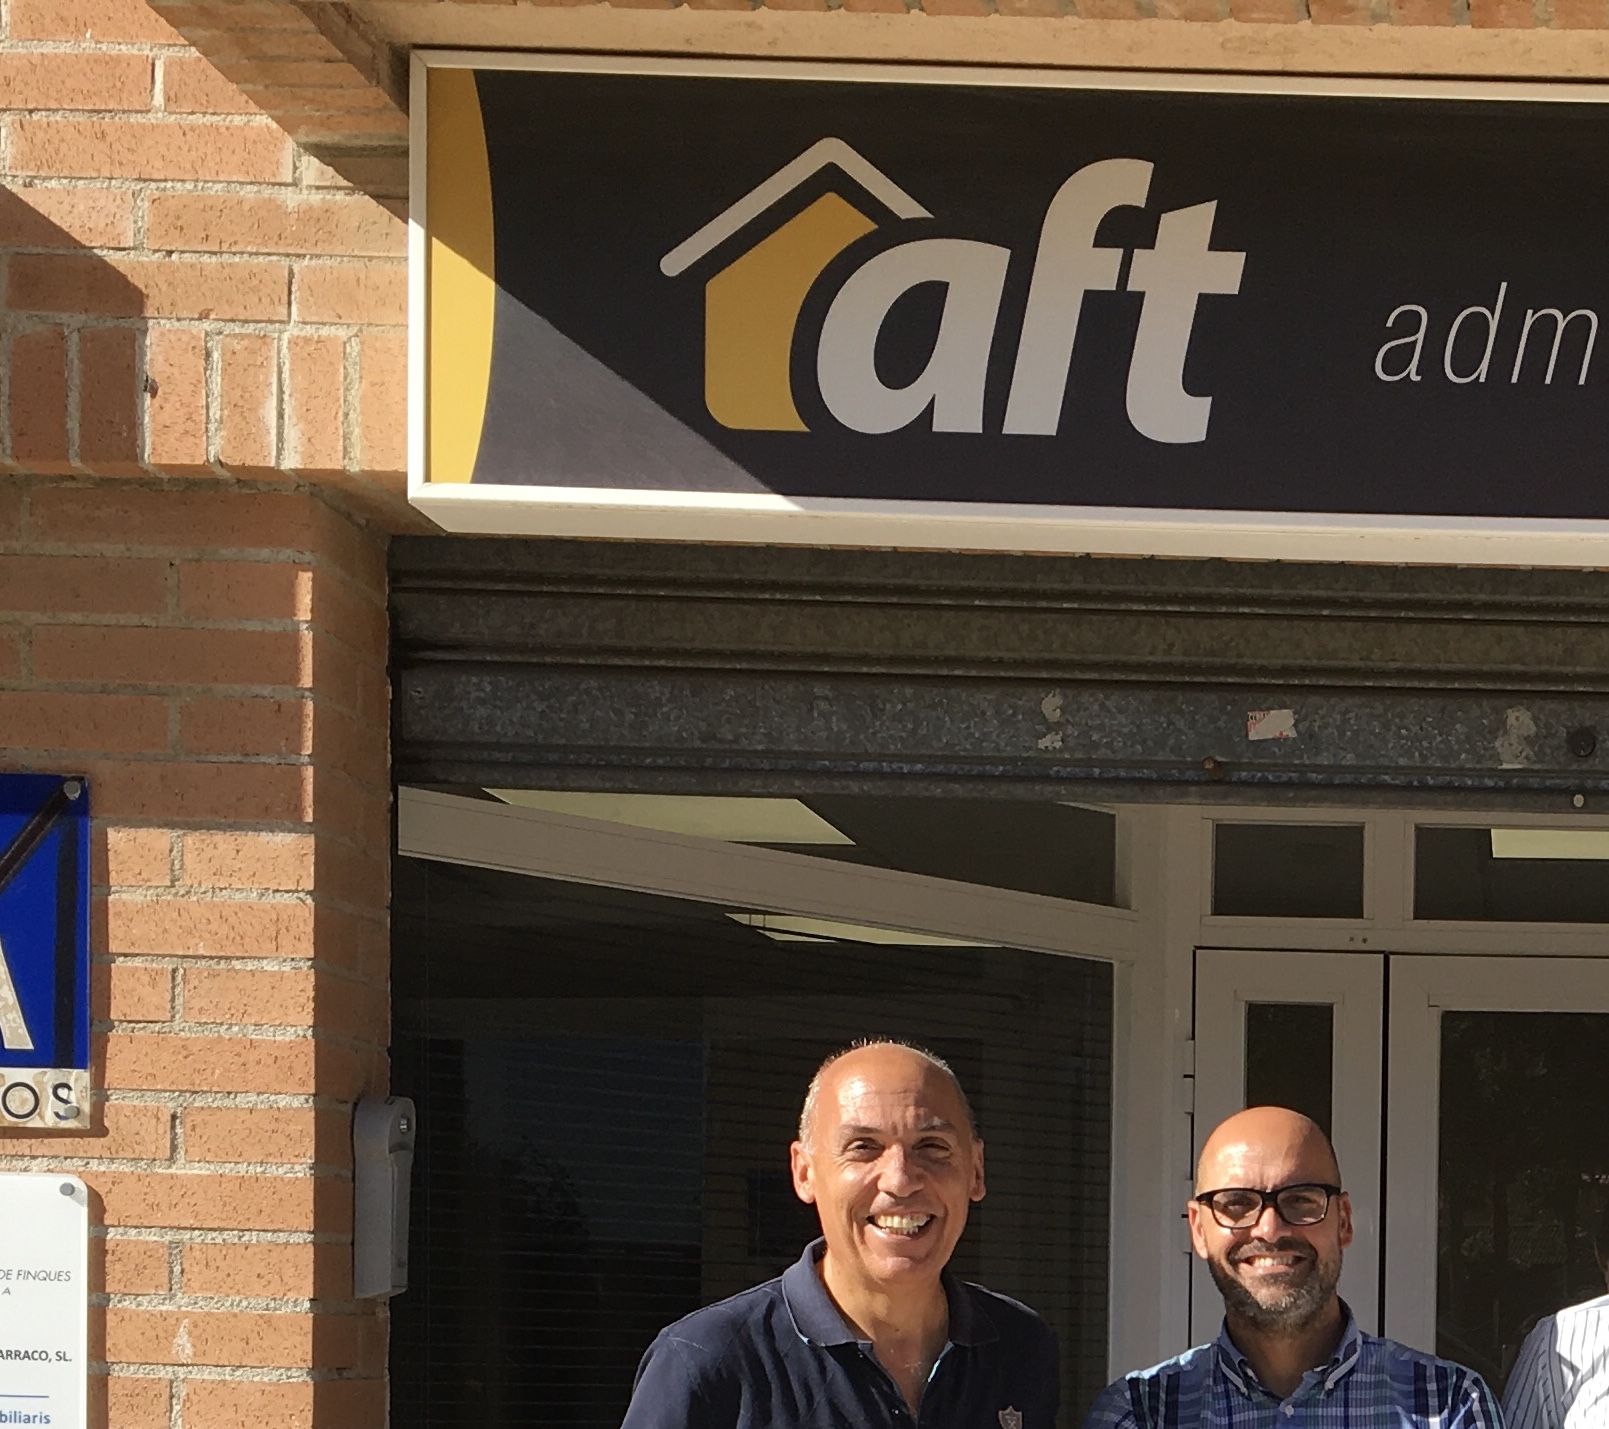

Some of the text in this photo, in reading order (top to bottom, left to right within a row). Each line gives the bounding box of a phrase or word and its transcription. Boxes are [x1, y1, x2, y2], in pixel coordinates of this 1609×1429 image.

[817, 159, 1247, 444] aft
[0, 1268, 72, 1282] DE FINQUES
[1, 1286, 11, 1296] A
[55, 1350, 73, 1362] SL.
